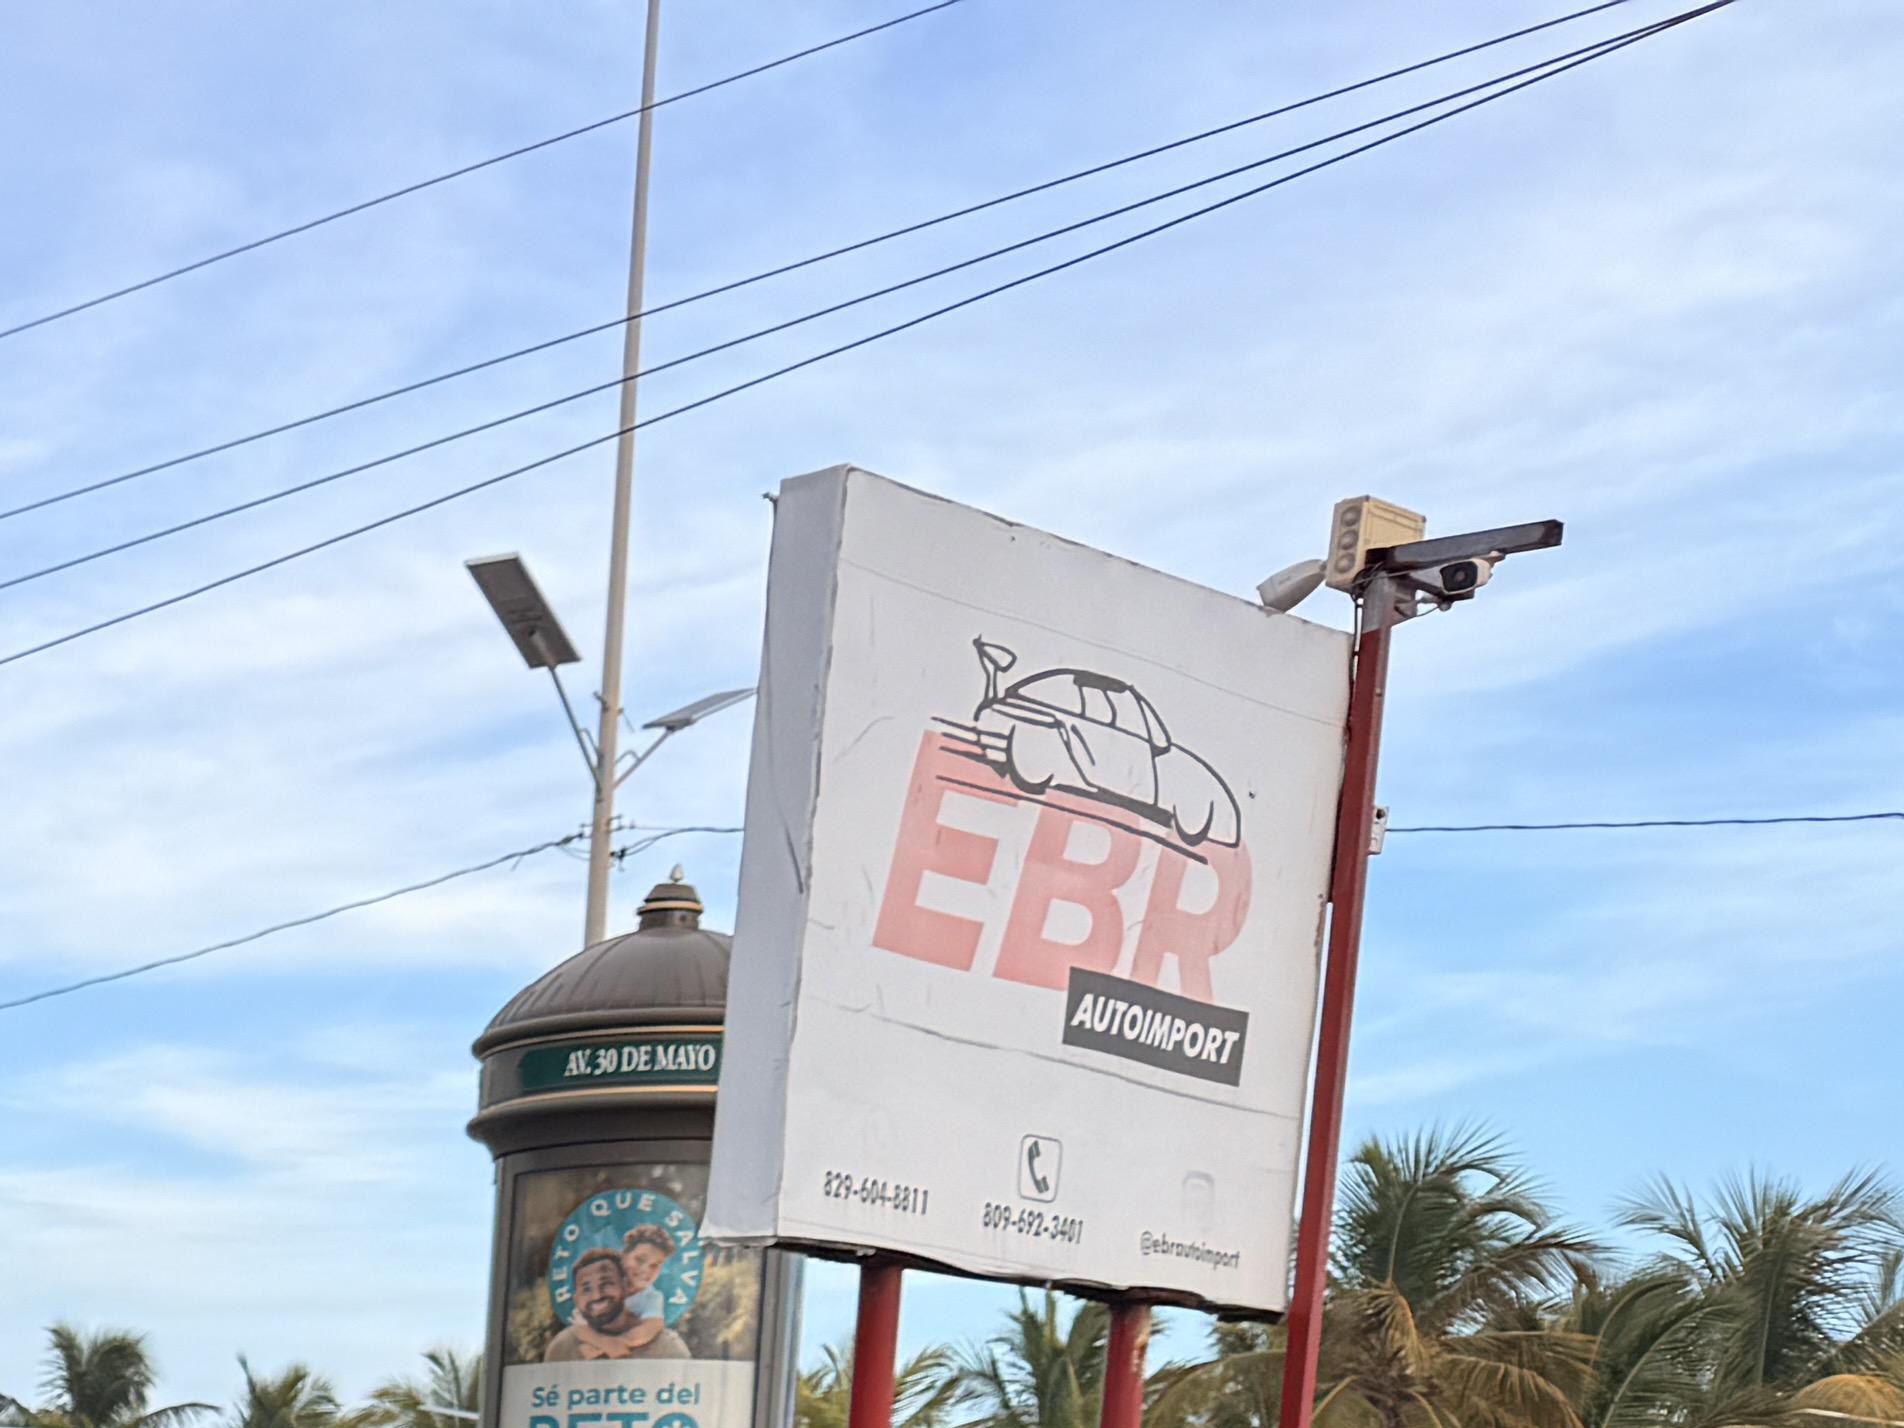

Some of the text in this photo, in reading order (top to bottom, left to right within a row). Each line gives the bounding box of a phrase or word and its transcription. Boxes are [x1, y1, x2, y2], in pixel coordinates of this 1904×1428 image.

[872, 730, 1253, 1003] EBR
[1070, 993, 1240, 1065] AUTOIMPORT
[563, 1043, 716, 1077] AV. 30 DE MAYO
[824, 1170, 929, 1215] 829-604-8811
[983, 1202, 1084, 1245] 809-692-3401
[552, 1191, 700, 1305] RETO QUE SALVA
[1140, 1230, 1240, 1271] @ebrautoimport
[532, 1381, 700, 1410] Sé parte del
